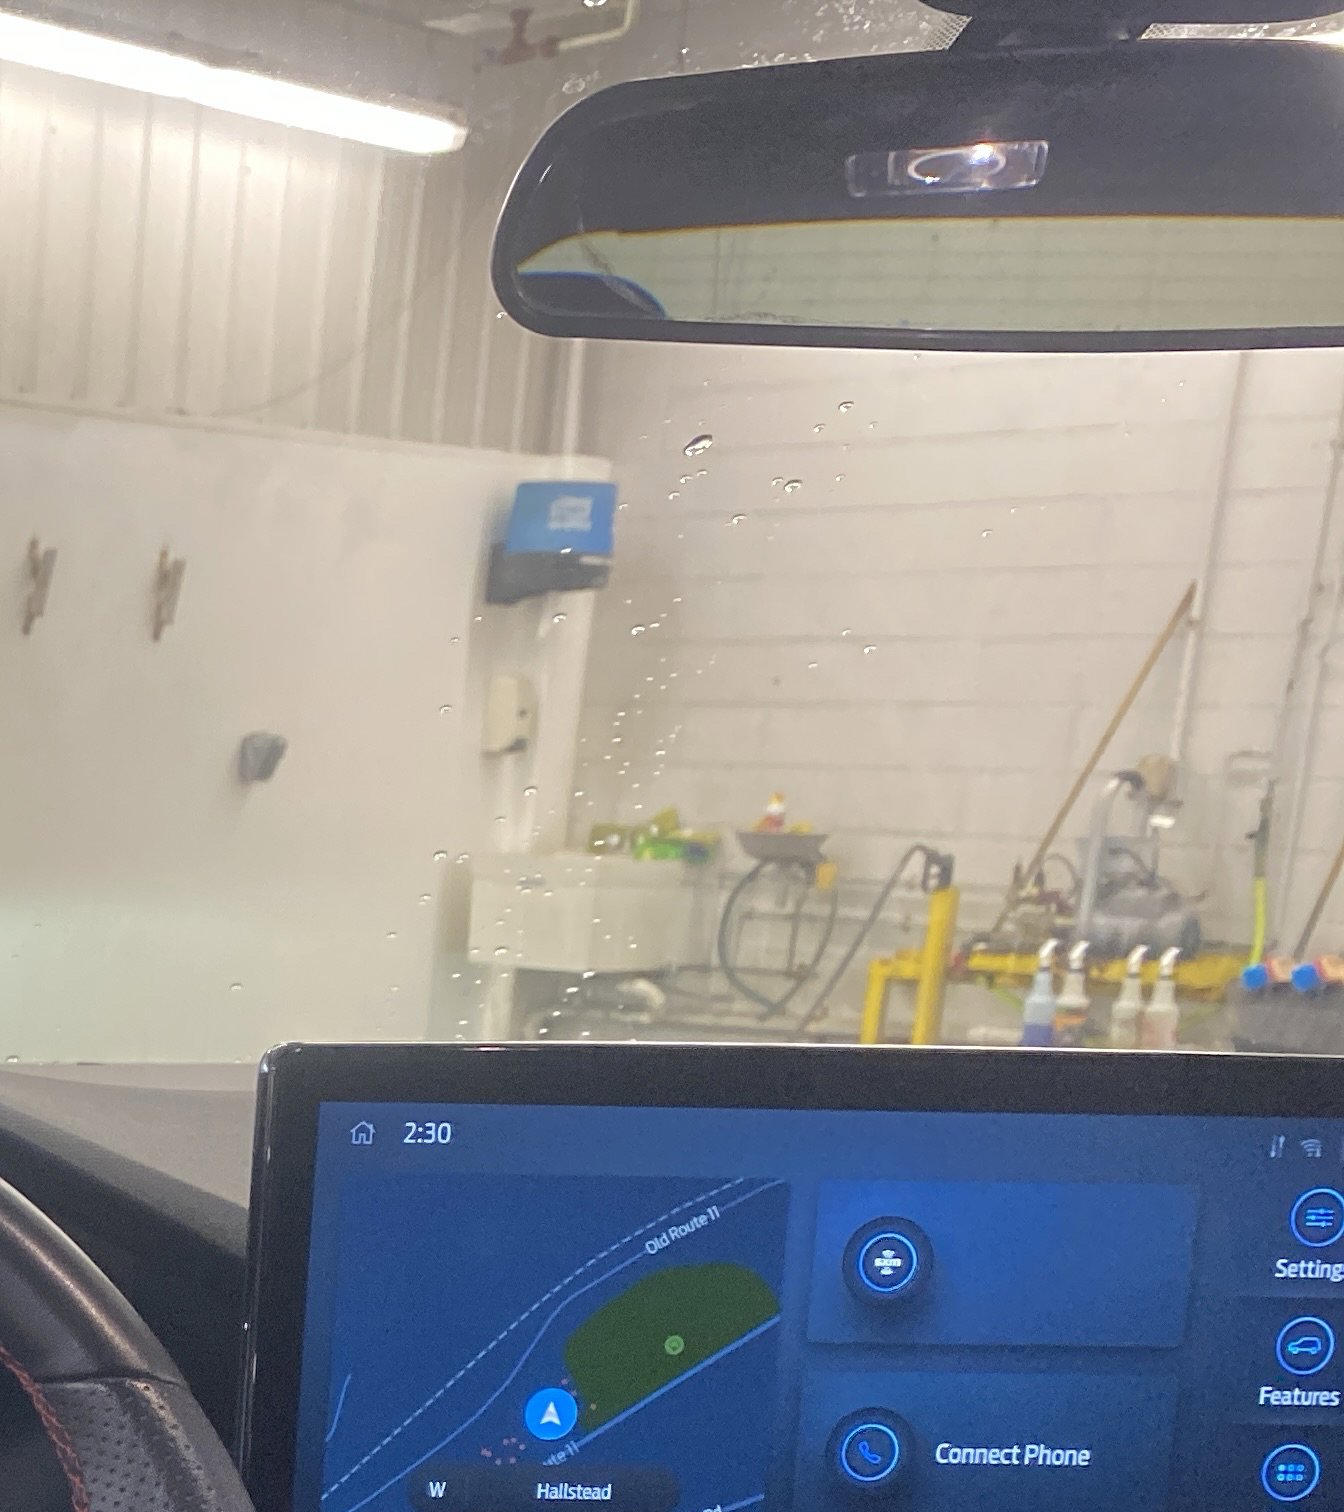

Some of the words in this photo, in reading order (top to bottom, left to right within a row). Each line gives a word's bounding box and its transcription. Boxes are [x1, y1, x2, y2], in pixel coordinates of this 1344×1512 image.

[402, 1122, 452, 1145] 2:30
[645, 1232, 670, 1255] Old
[668, 1214, 709, 1241] Route
[706, 1205, 721, 1221] 11
[1274, 1258, 1344, 1282] Setting
[1259, 1386, 1340, 1408] Features
[935, 1442, 1021, 1465] Connect
[1024, 1444, 1091, 1467] Phone
[428, 1481, 447, 1499] W
[536, 1482, 613, 1502] Hallstead
